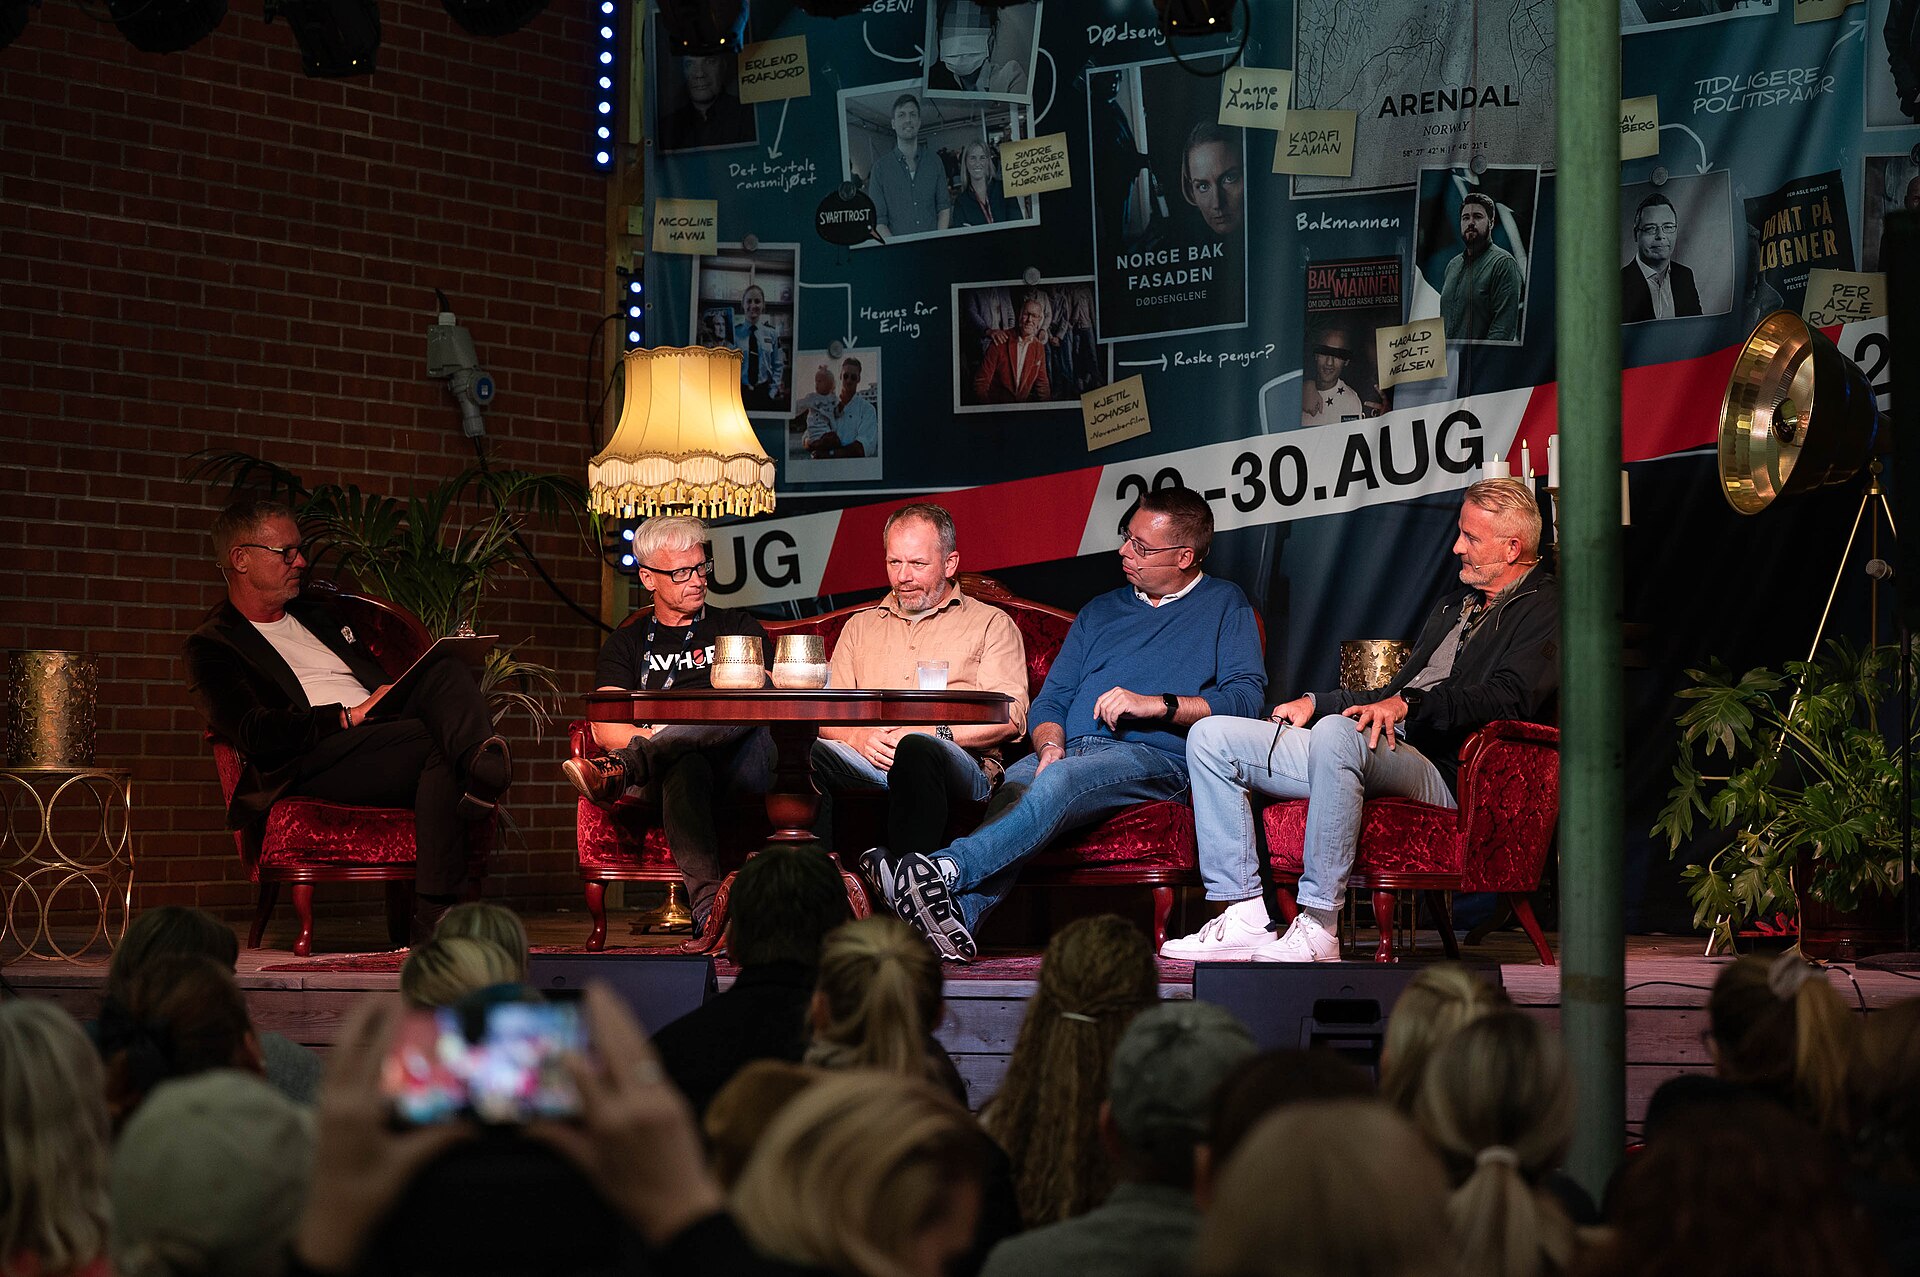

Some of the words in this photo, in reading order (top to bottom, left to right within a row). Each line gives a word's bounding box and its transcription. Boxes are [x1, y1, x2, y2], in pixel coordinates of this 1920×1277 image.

[745, 53, 798, 71] ERLEND
[741, 66, 805, 86] FRAFJORD
[1694, 66, 1820, 95] TIDLIGERE
[1229, 78, 1278, 95] Janne
[1692, 75, 1835, 115] POLITISPANER
[1225, 93, 1278, 111] Amble
[1377, 85, 1519, 119] ARENDAL
[1289, 130, 1339, 145] KADAFI
[1423, 121, 1470, 137] NORWAY
[1015, 145, 1053, 160] SINDRE
[1287, 142, 1342, 157] ZAMAN
[728, 163, 757, 177] Det
[763, 158, 816, 174] brutale
[1005, 151, 1065, 172] LEGANGER
[736, 172, 817, 193] ransmiljøet
[1011, 168, 1030, 179] OG
[819, 208, 871, 225] SVARTTROST
[1296, 211, 1400, 231] Bakmannen
[1811, 195, 1833, 227] PÅ
[658, 217, 713, 227] NICOLINE
[1116, 248, 1180, 270] NORGE
[1188, 242, 1224, 262] BAK
[1759, 228, 1839, 272] LØGNER
[1128, 266, 1213, 290] FASADEN
[1308, 268, 1337, 290] BAK
[1333, 273, 1399, 298] MANNEN
[1136, 290, 1207, 307] DØDSENGLENE
[1833, 284, 1870, 300] PER
[860, 306, 907, 320] Hennes
[913, 301, 938, 316] far
[1823, 297, 1873, 314] ASLE
[880, 317, 920, 339] Erling
[1389, 331, 1431, 348] HARALD
[1174, 349, 1213, 367] Raske
[1218, 343, 1275, 368] penger?
[1094, 389, 1130, 410] KJETIL
[1090, 399, 1139, 425] JOHNSEN
